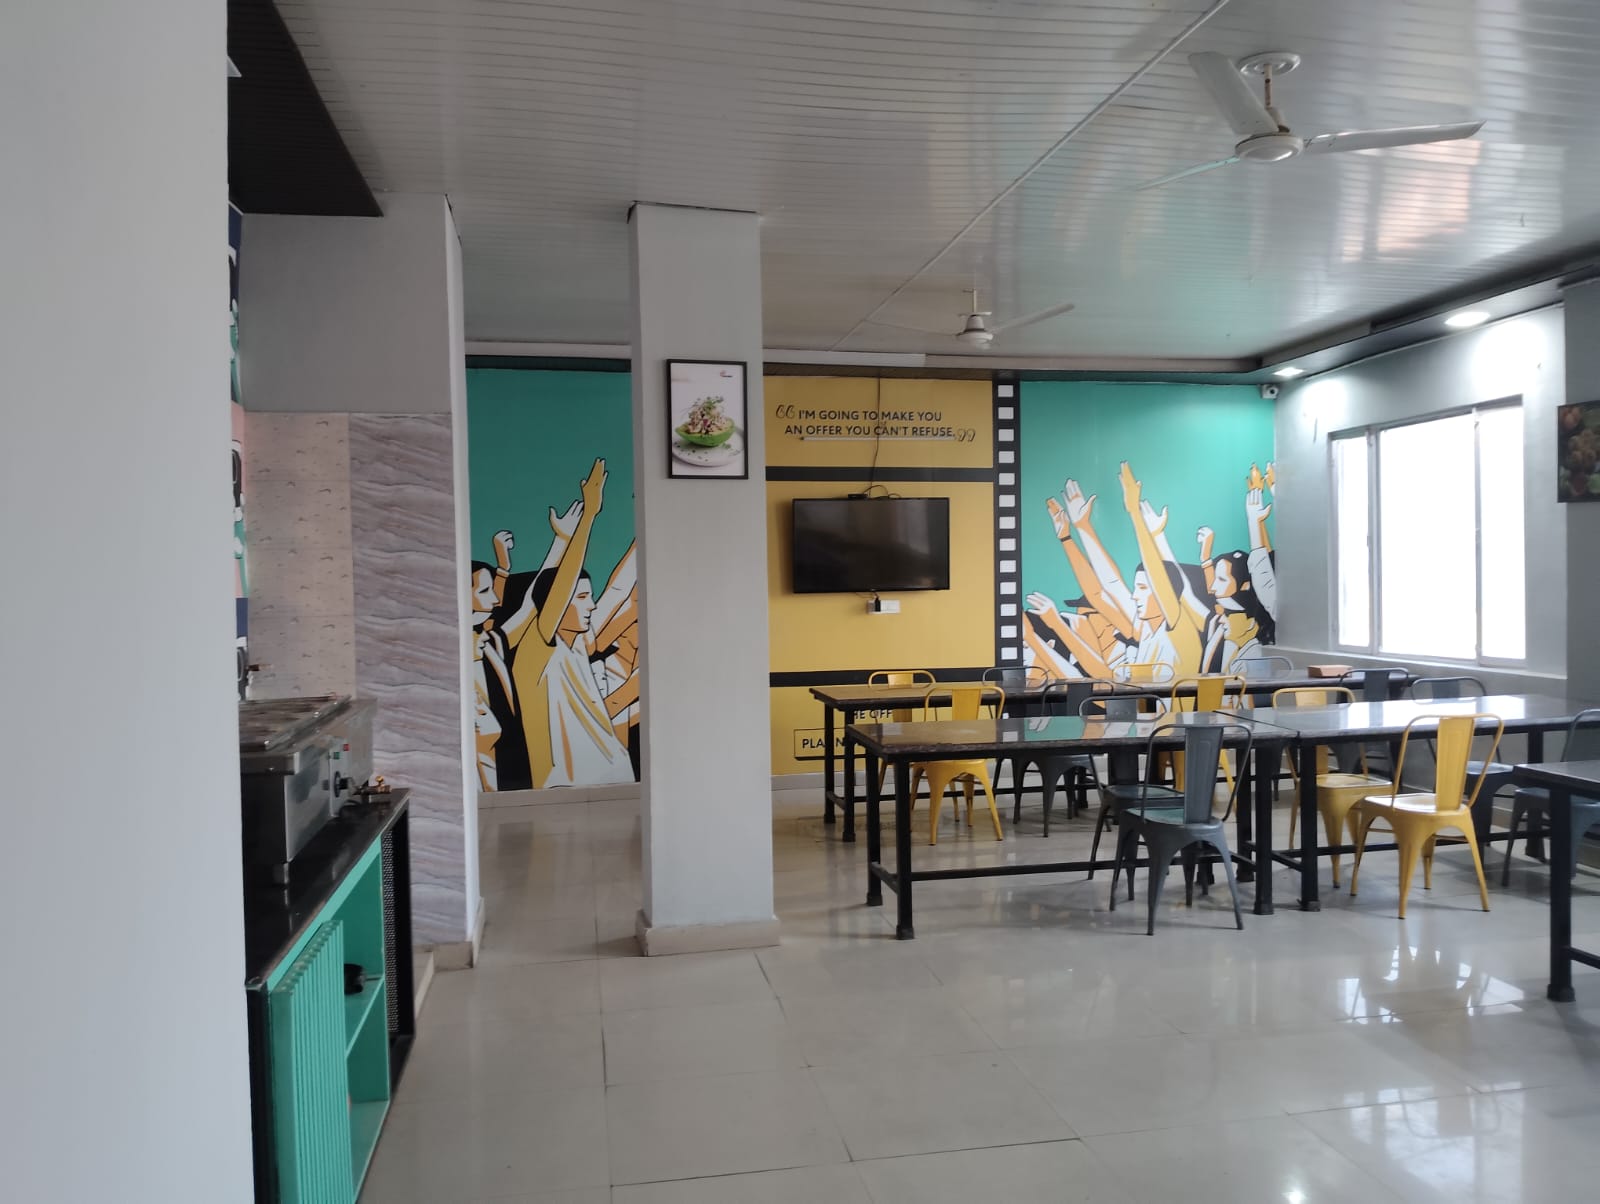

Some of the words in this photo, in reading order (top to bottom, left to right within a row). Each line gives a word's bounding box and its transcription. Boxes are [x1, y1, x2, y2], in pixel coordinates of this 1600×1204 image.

[818, 410, 860, 421] GOING
[862, 410, 879, 421] TO
[881, 411, 915, 422] MAKE
[917, 411, 942, 422] YOU
[784, 424, 803, 435] AN
[805, 425, 842, 435] OFFER
[845, 425, 871, 436] YOU
[873, 425, 909, 436] CAN'T
[911, 426, 956, 437] REFUSE.
[802, 738, 826, 748] PLA
